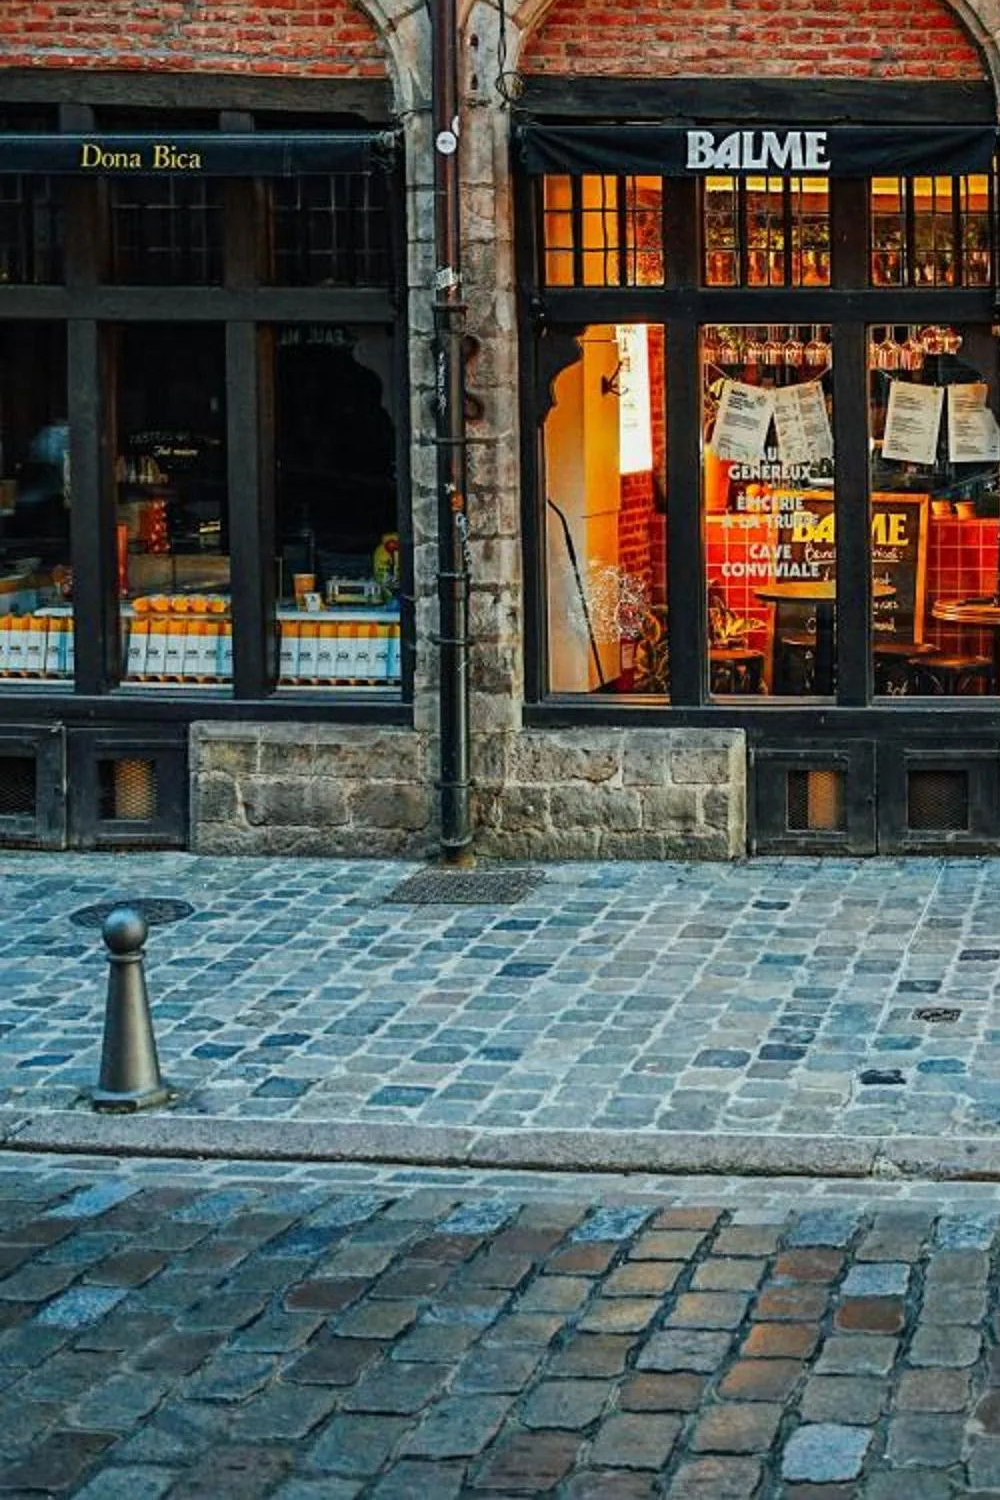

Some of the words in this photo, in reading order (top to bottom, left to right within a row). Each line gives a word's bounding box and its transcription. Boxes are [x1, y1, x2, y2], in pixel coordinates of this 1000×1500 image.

[81, 143, 141, 168] Dona
[153, 145, 201, 168] Bica
[686, 131, 831, 170] BALME
[750, 545, 792, 559] CAVE
[722, 563, 820, 577] CONVIVIALE
